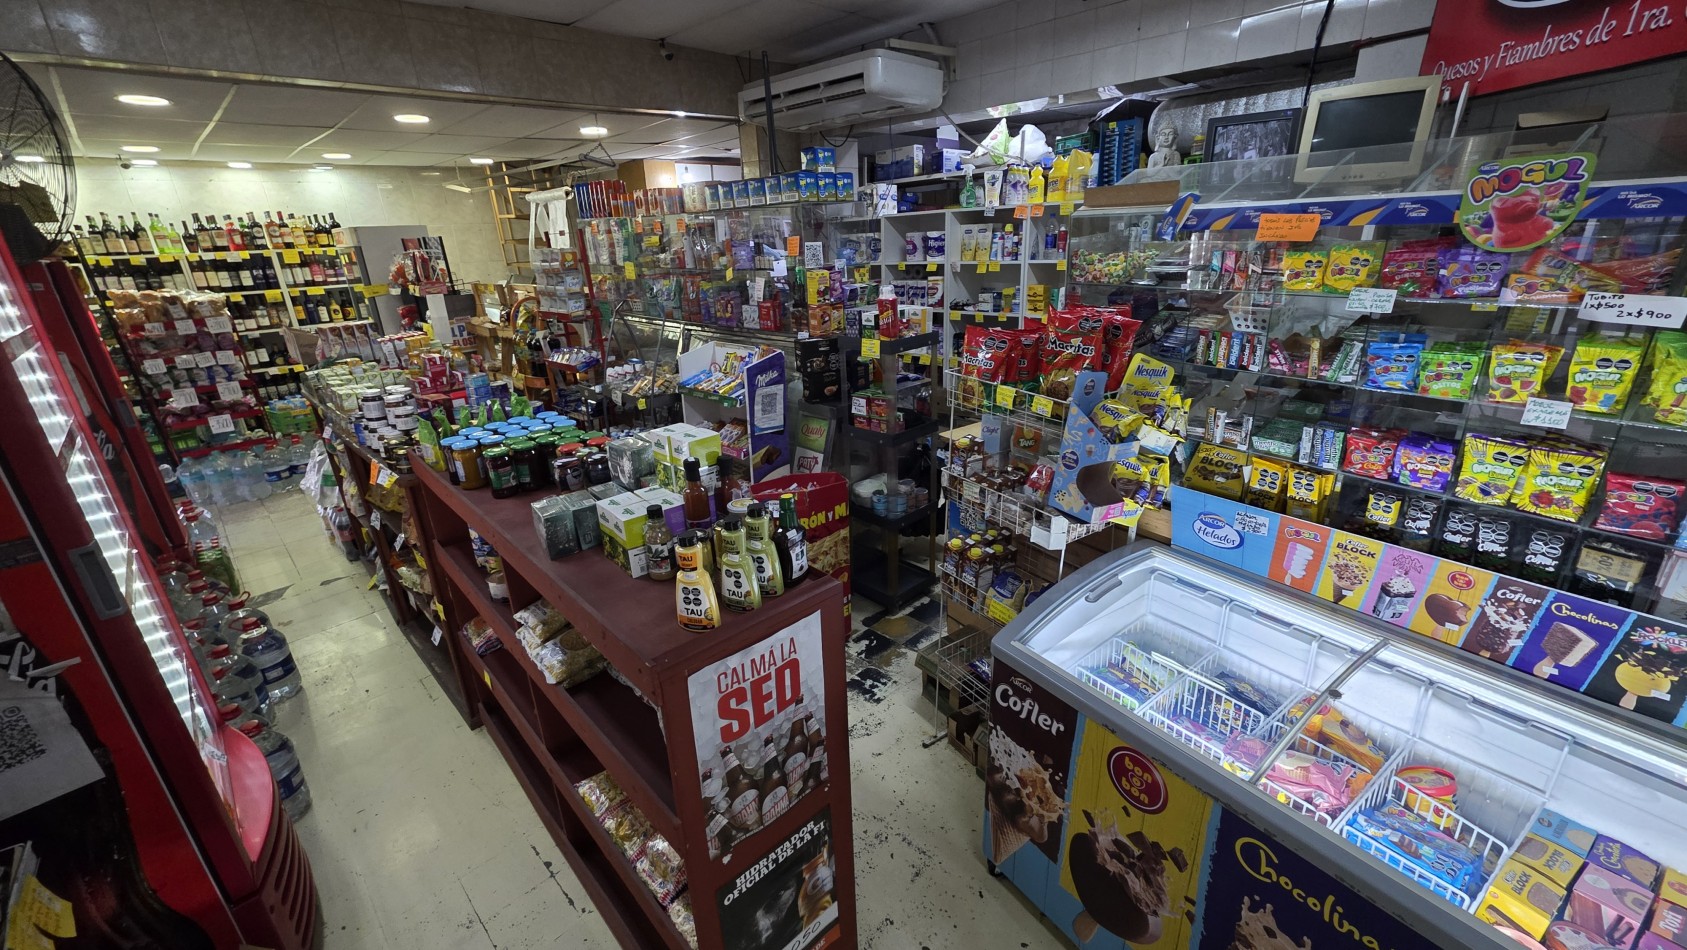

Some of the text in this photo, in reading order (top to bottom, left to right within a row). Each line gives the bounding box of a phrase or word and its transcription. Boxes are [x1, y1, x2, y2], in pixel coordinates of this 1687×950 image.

[1433, 0, 1673, 82] Quesos y Fiambres de 1ra.
[1470, 157, 1586, 202] MOGUL
[1048, 337, 1094, 356] Macritas
[1208, 339, 1216, 362] beldent
[1229, 338, 1241, 365] beldent
[1242, 343, 1250, 366] beldent
[755, 369, 779, 388] Milka
[1135, 364, 1168, 378] Nesquik
[1425, 373, 1463, 383] MOGUL
[1574, 373, 1622, 383] MOGUL
[1130, 389, 1161, 398] Nesquik
[1100, 404, 1129, 421] Nesqui
[801, 423, 826, 439] Qualy
[982, 426, 1000, 435] Clight
[1019, 439, 1036, 447] TANG
[799, 457, 816, 470] PATY
[1199, 455, 1243, 470] BLOCK
[1214, 450, 1238, 461] Cofler
[1352, 453, 1385, 464] MOGUL
[1471, 463, 1515, 478] MOGUL
[1535, 475, 1584, 490] MOGUL
[800, 510, 826, 530] RÓN
[1201, 516, 1226, 529] ARCOR
[1368, 512, 1392, 523] Cofler
[1197, 526, 1237, 546] Helados
[1285, 527, 1320, 542] MOGUL
[1336, 542, 1377, 559] BLOCK
[1346, 538, 1369, 550] Cofler
[727, 588, 742, 599] TAU
[1496, 588, 1541, 606] Cofler
[684, 607, 703, 617] TAU
[1551, 602, 1619, 630] Chocolinas
[1638, 631, 1687, 649] ROCKLE
[717, 637, 798, 694] CALMÁ LA
[1009, 676, 1033, 694] ARCOR
[718, 657, 802, 744] SED
[995, 683, 1065, 736] Cofler
[1124, 755, 1152, 783] bon
[1121, 777, 1149, 805] bon
[735, 820, 815, 888] HIDRATADOR
[1543, 849, 1565, 870] BLOCK
[723, 861, 776, 906] OFICIAL
[778, 845, 794, 864] DE
[796, 833, 812, 850] LA
[1511, 871, 1532, 896] BLOCK
[1235, 837, 1394, 950] Chocolina
